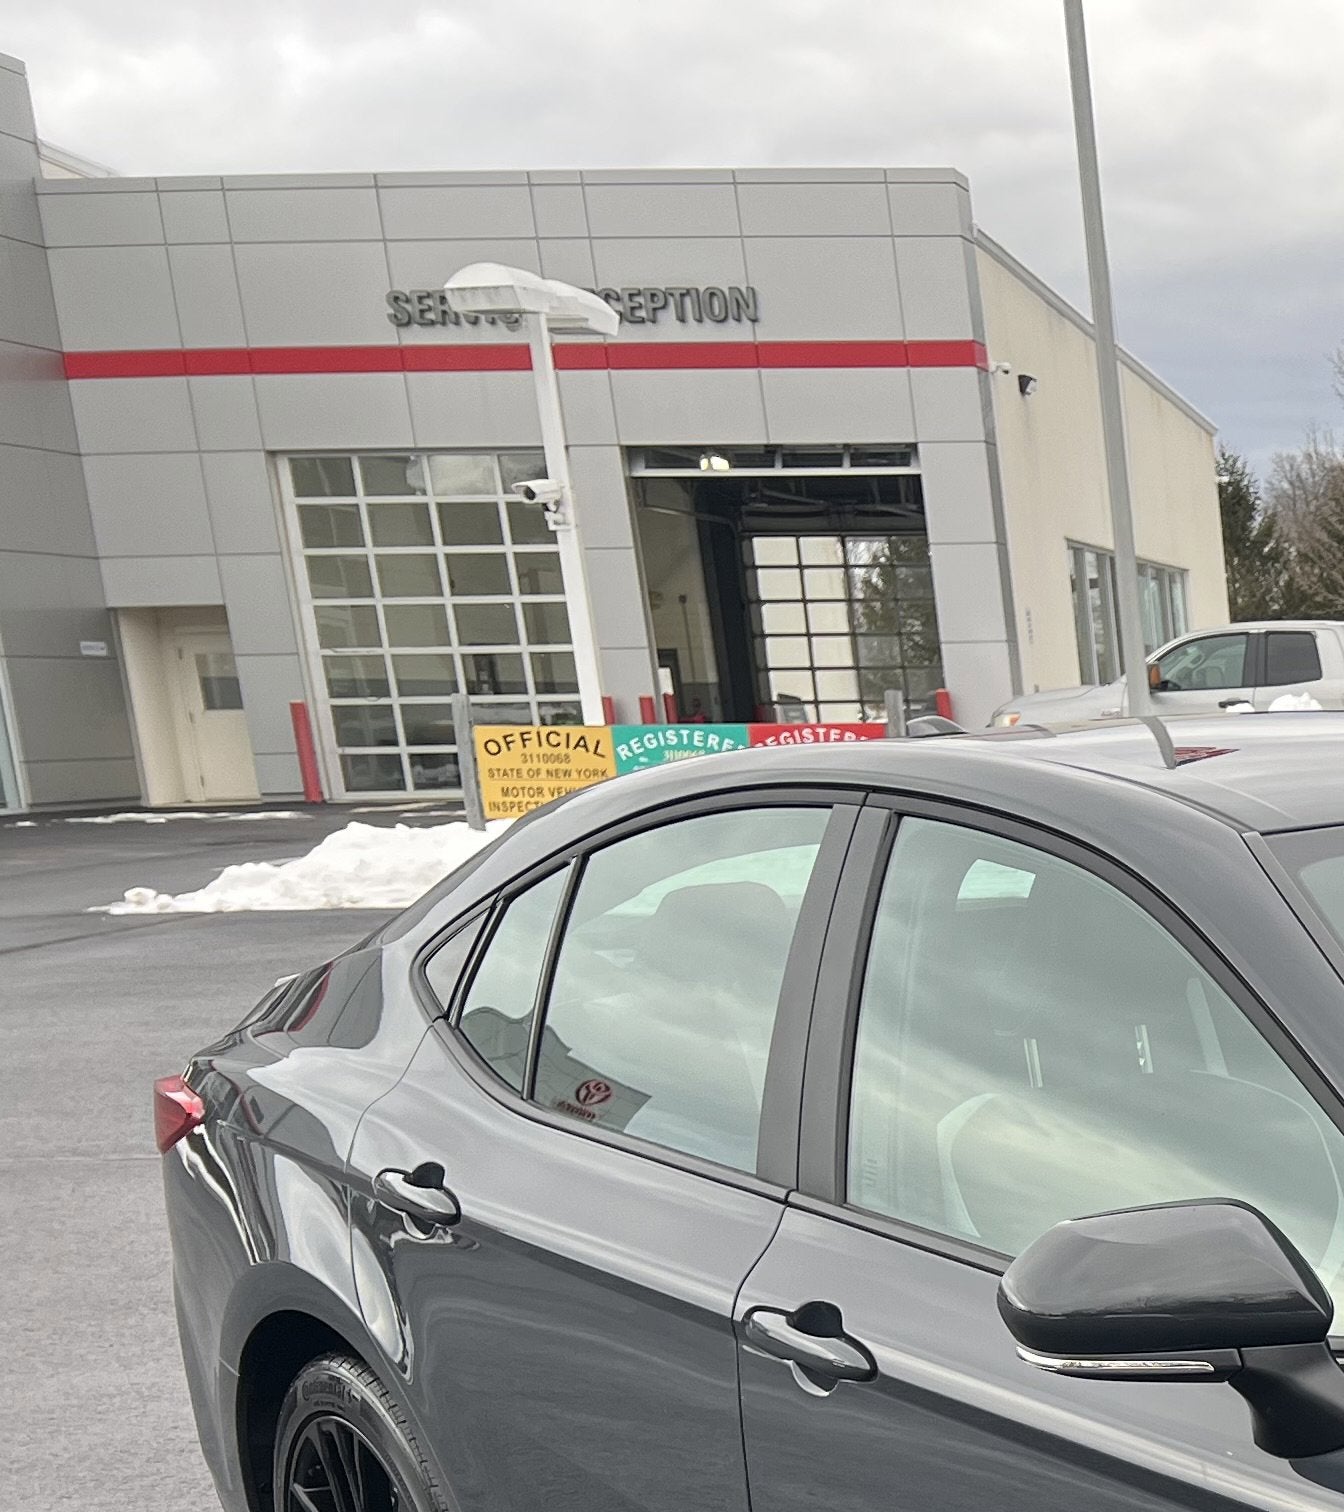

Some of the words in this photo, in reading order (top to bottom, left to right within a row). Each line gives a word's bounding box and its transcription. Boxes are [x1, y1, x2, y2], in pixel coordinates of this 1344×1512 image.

[484, 730, 607, 758] OFFICIAL
[616, 729, 746, 761] REGISTERE
[488, 767, 524, 779] STATE
[527, 767, 541, 779] OF
[546, 767, 572, 778] NEW
[575, 767, 609, 778] YORK
[501, 786, 545, 798] MOTOR
